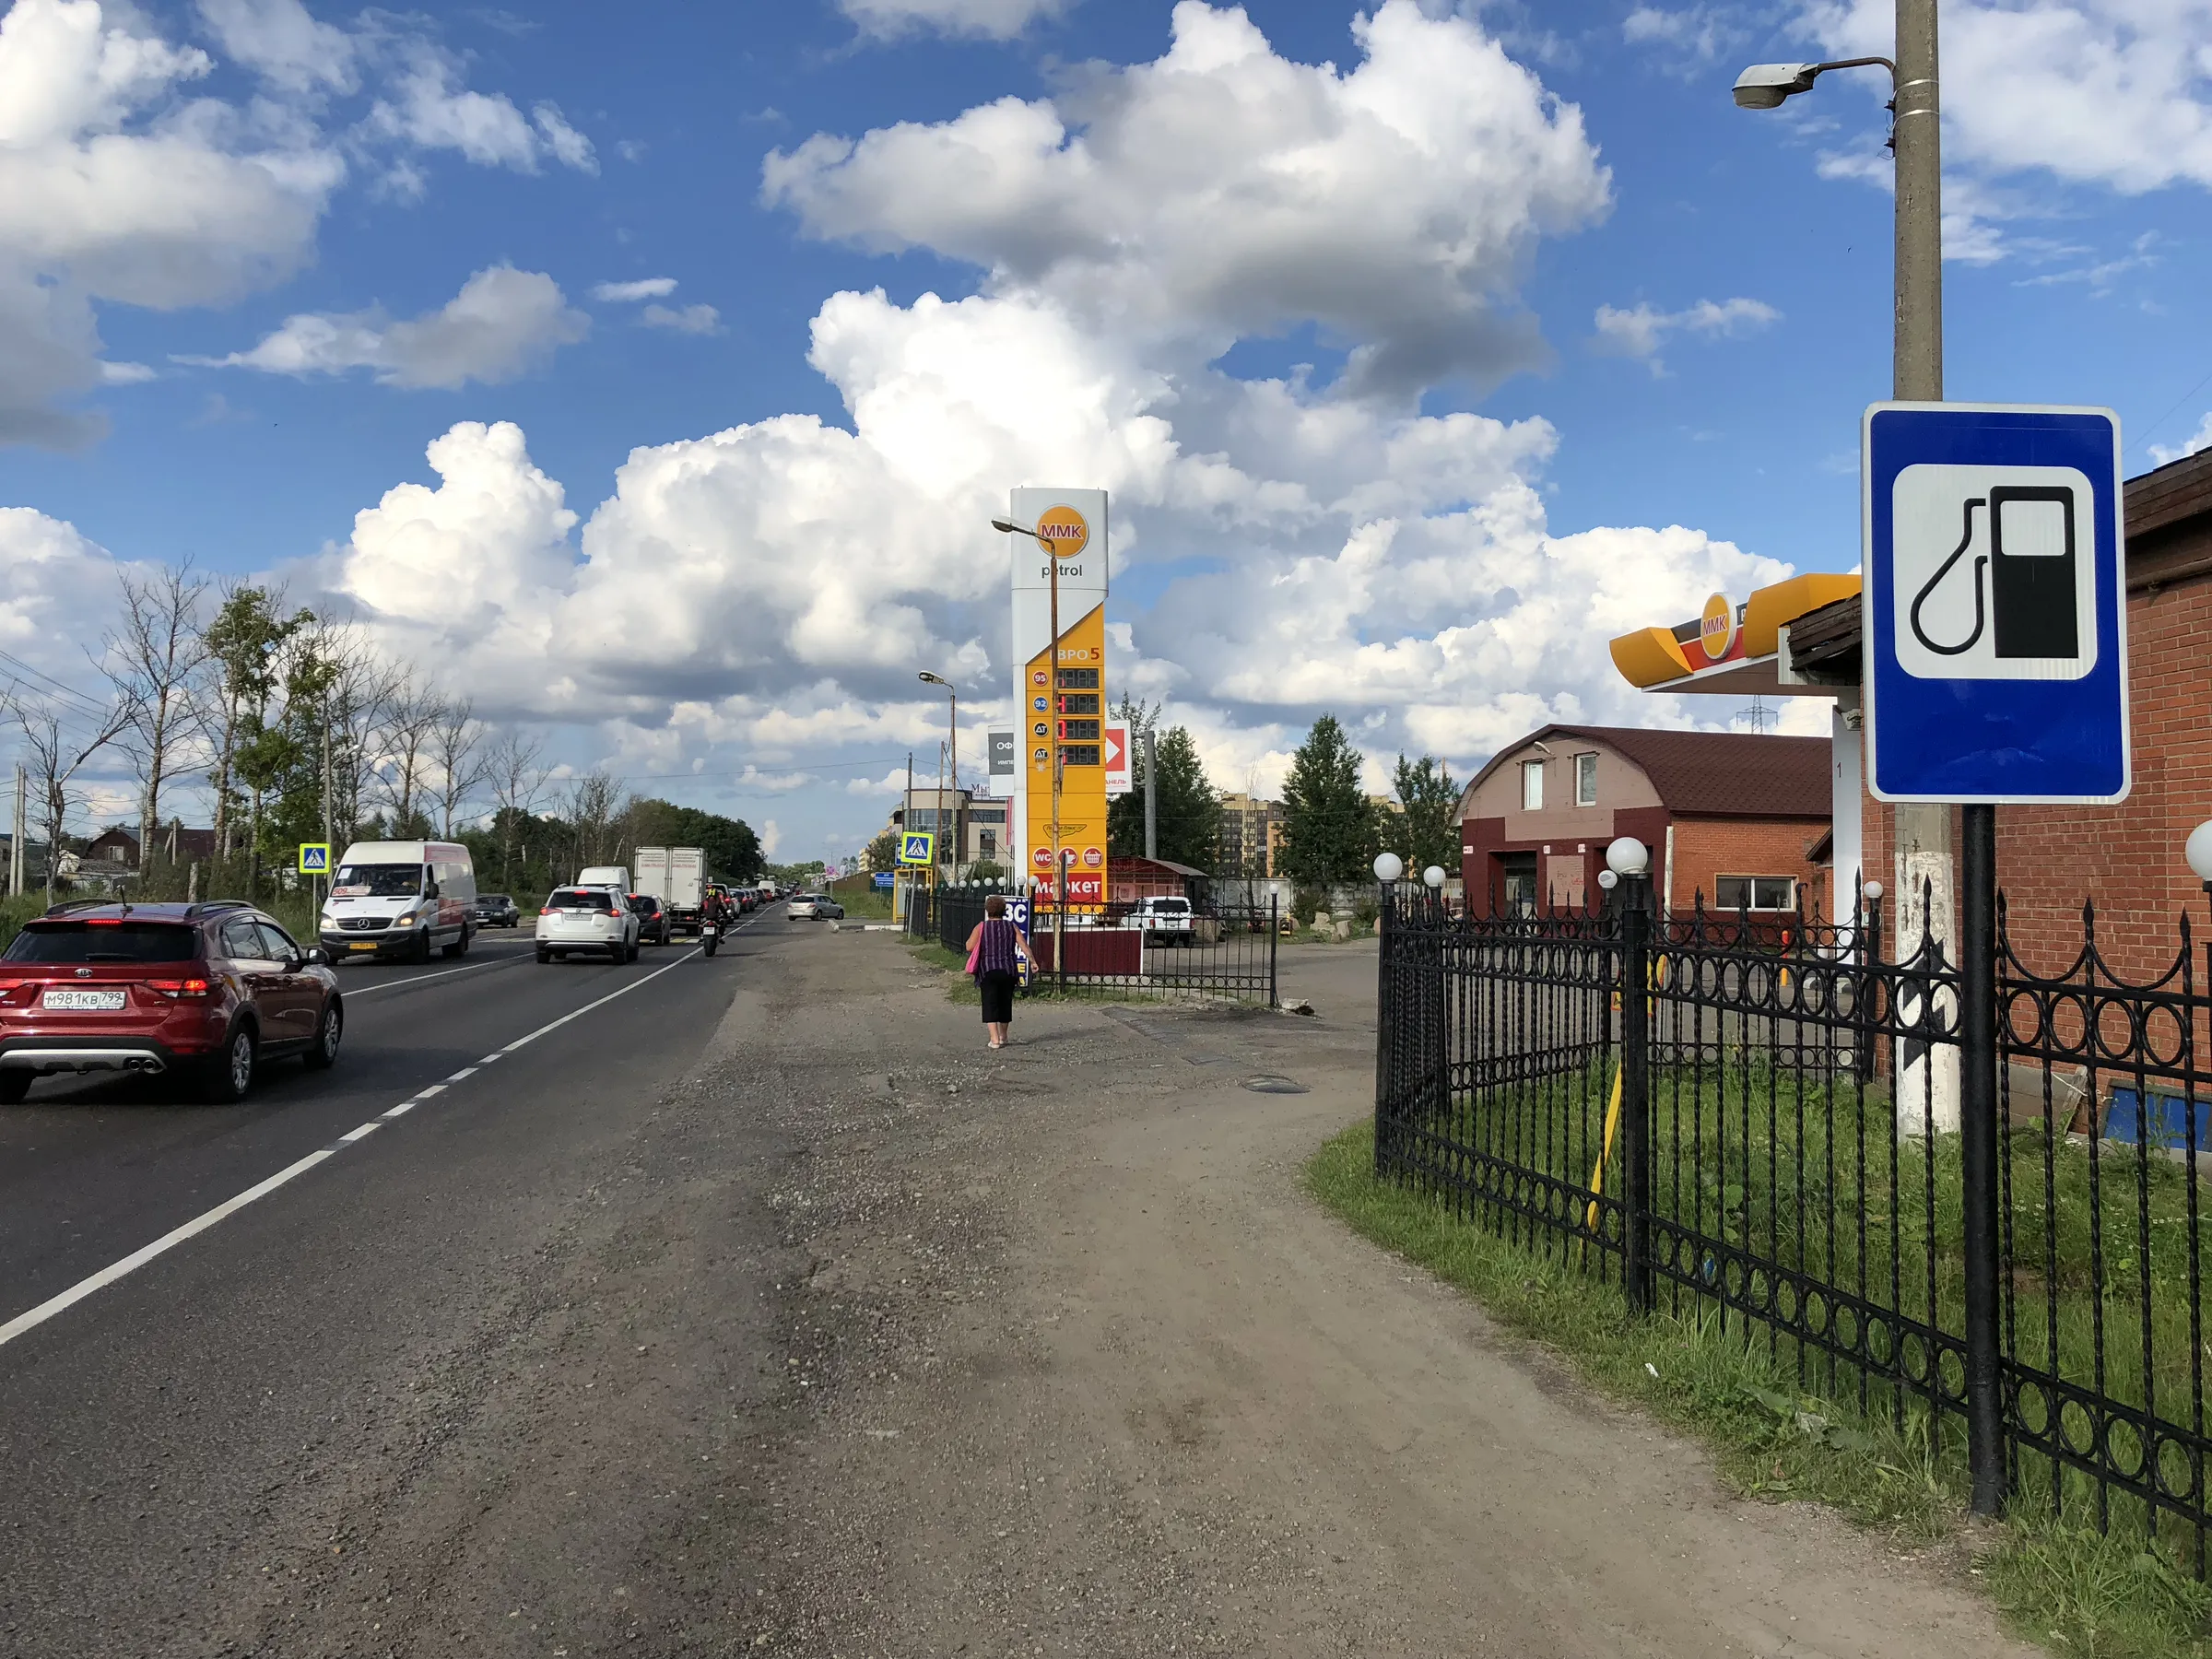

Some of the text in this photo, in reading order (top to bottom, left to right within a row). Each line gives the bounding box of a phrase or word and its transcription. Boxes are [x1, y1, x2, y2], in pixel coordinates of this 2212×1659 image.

[1041, 564, 1083, 579] ptrol
[1049, 647, 1100, 661] ВРО 5
[996, 741, 1014, 750] ОФ
[1836, 762, 1842, 778] 1
[1034, 853, 1052, 862] WC
[101, 992, 122, 1002] 799
